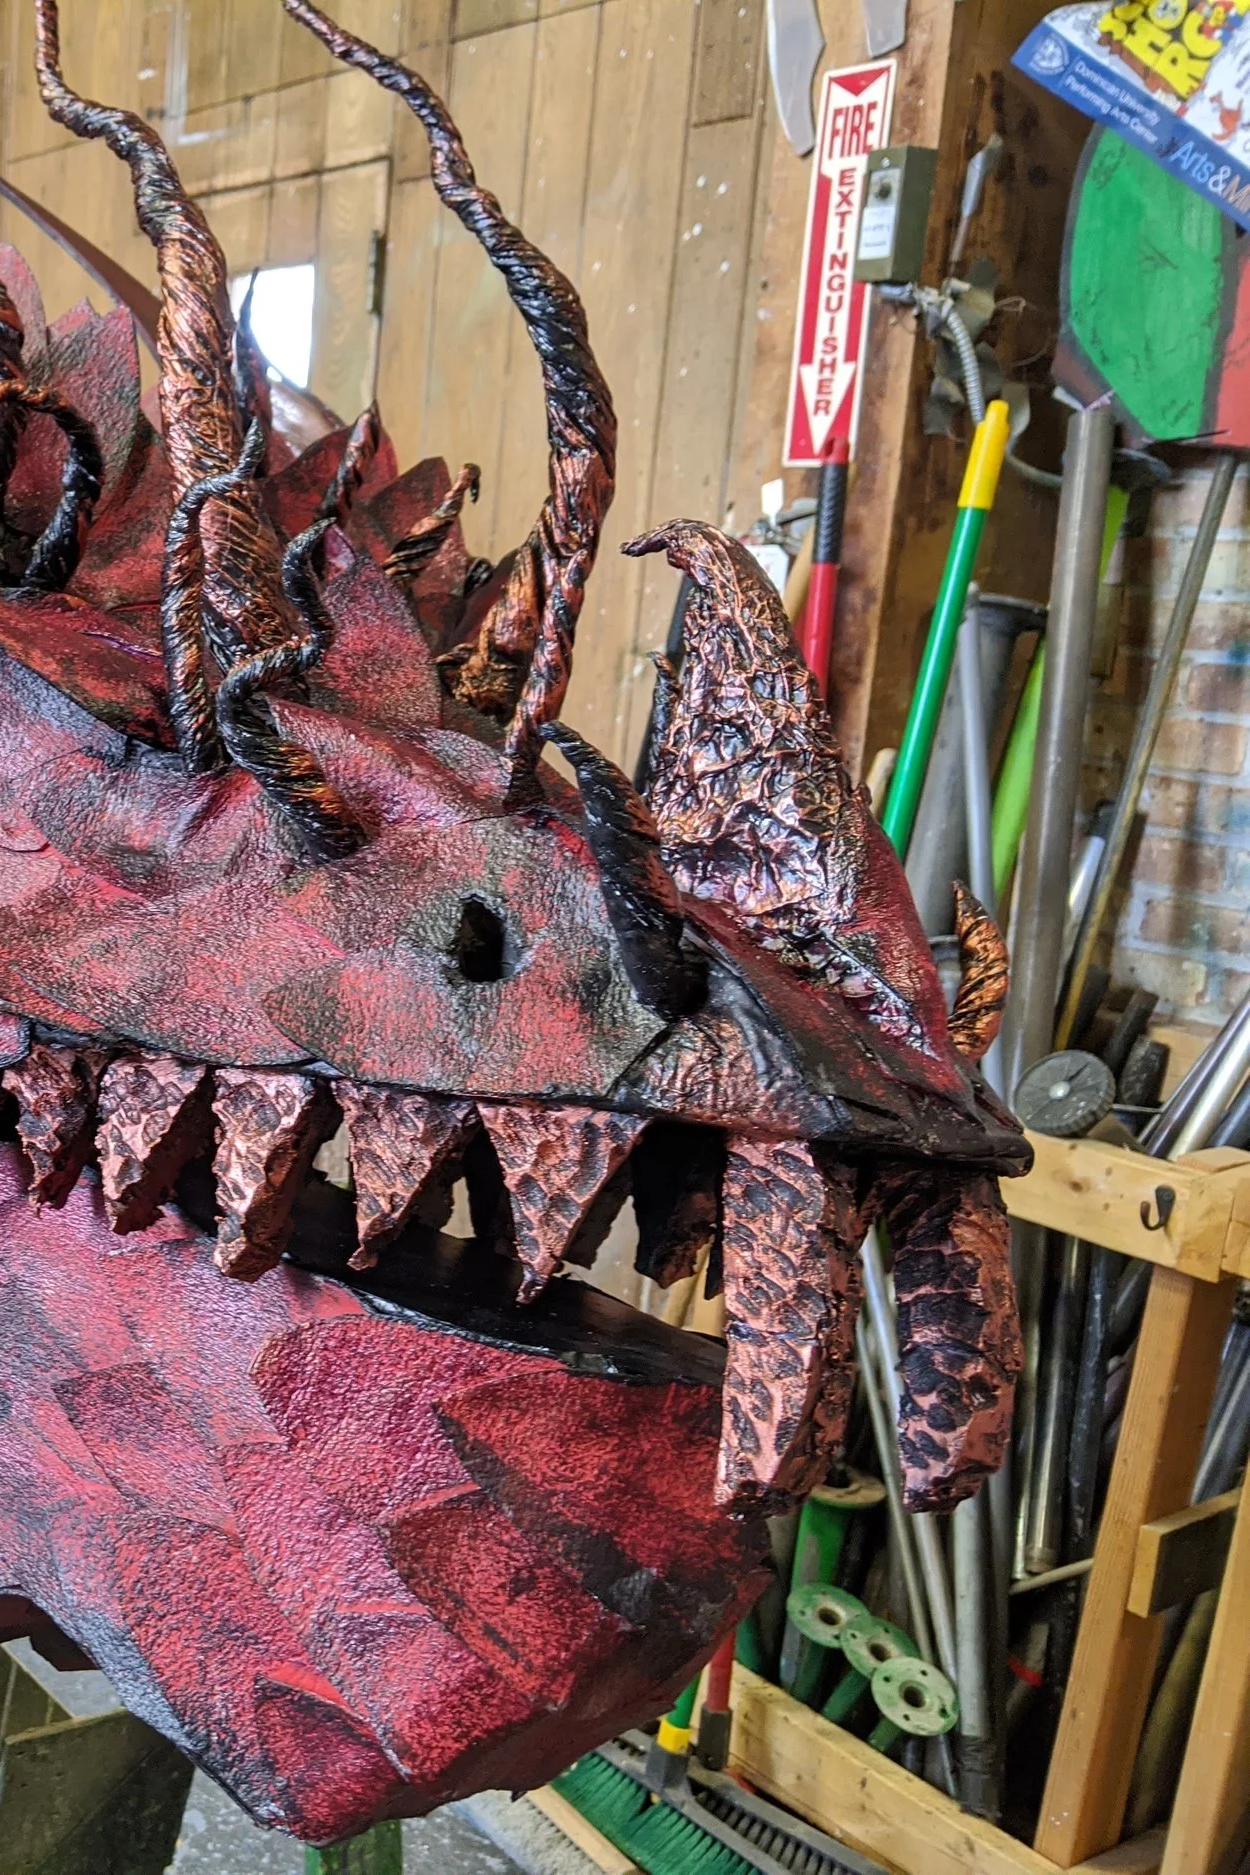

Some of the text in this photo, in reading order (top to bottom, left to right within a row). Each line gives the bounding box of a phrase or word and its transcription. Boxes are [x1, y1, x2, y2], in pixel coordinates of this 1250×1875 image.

[1064, 75, 1159, 144] Performing Arts Center
[1075, 60, 1160, 126] Dominican University
[828, 101, 878, 160] FIRE
[813, 167, 858, 417] EXTINGUISHER
